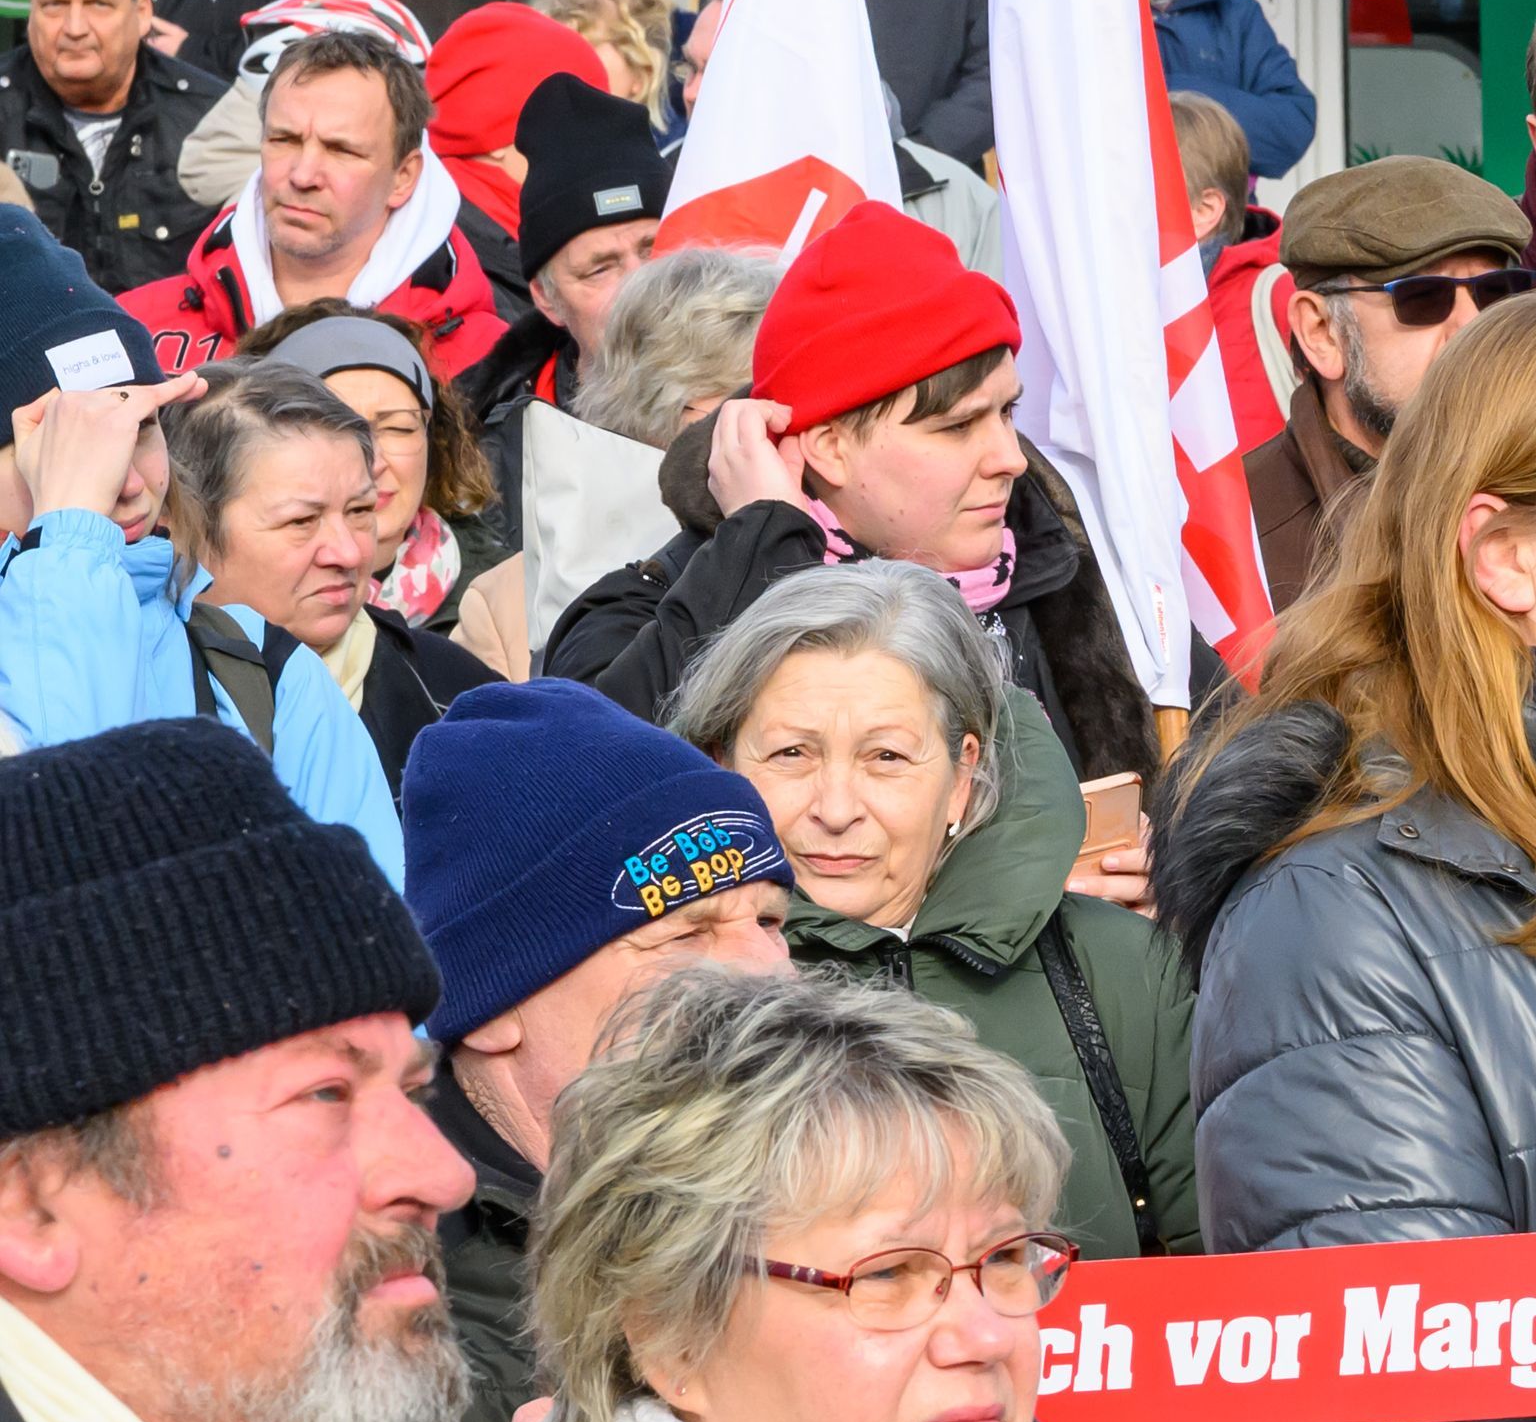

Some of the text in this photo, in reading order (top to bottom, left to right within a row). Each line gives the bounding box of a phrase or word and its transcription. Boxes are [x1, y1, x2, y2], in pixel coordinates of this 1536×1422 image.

[623, 819, 732, 886] Be Bob
[689, 847, 744, 894] Bop
[1165, 1312, 1312, 1386] vor
